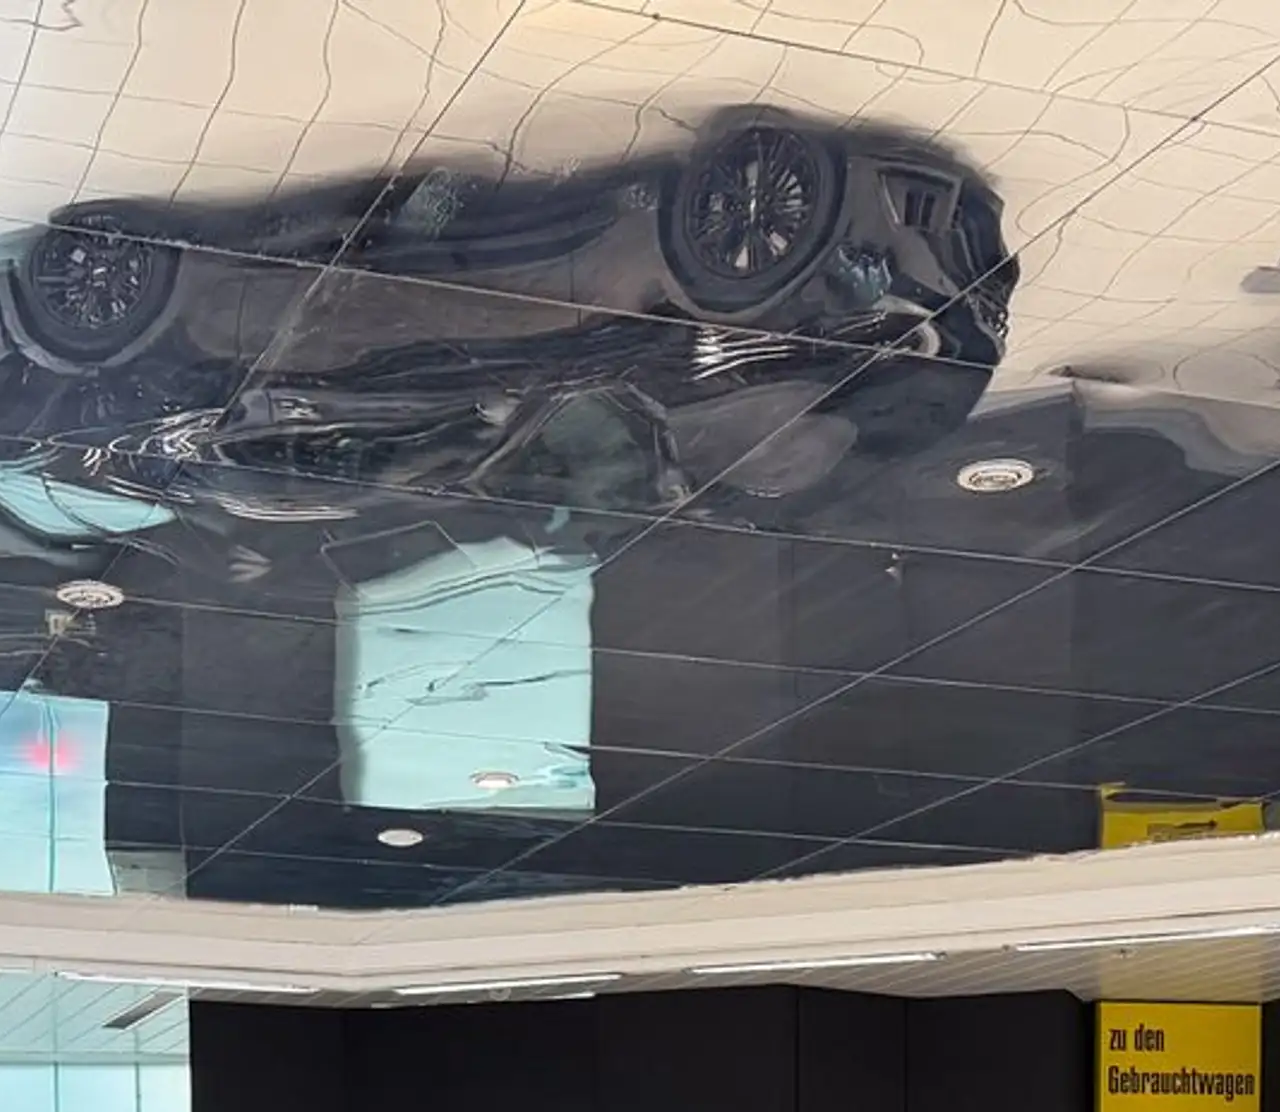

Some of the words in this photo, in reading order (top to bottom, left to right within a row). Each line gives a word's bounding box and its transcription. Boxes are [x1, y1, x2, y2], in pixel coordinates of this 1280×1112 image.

[1109, 1028, 1127, 1051] zu
[1134, 1024, 1165, 1052] den
[1108, 1066, 1256, 1102] Gebrauchtwagen
